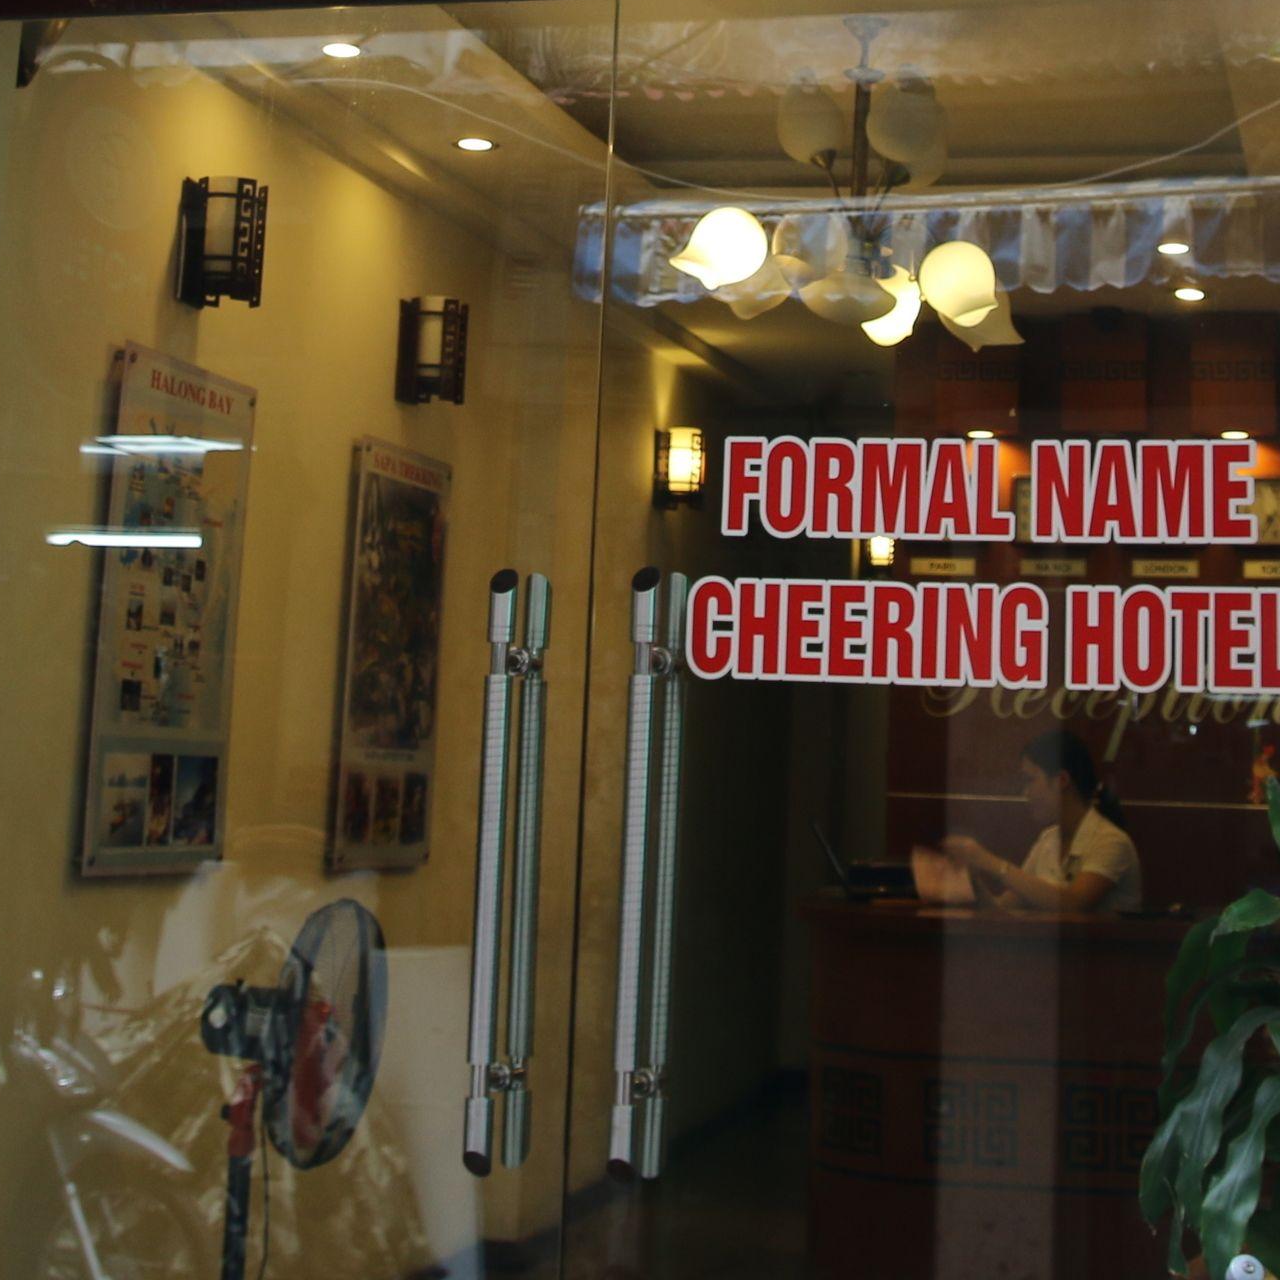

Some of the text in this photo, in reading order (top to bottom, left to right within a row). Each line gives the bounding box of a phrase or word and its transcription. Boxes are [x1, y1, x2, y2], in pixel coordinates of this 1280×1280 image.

[150, 368, 235, 415] HALONG BAY
[721, 436, 1258, 545] FORMAL NAME
[686, 576, 1049, 690] CHEERING
